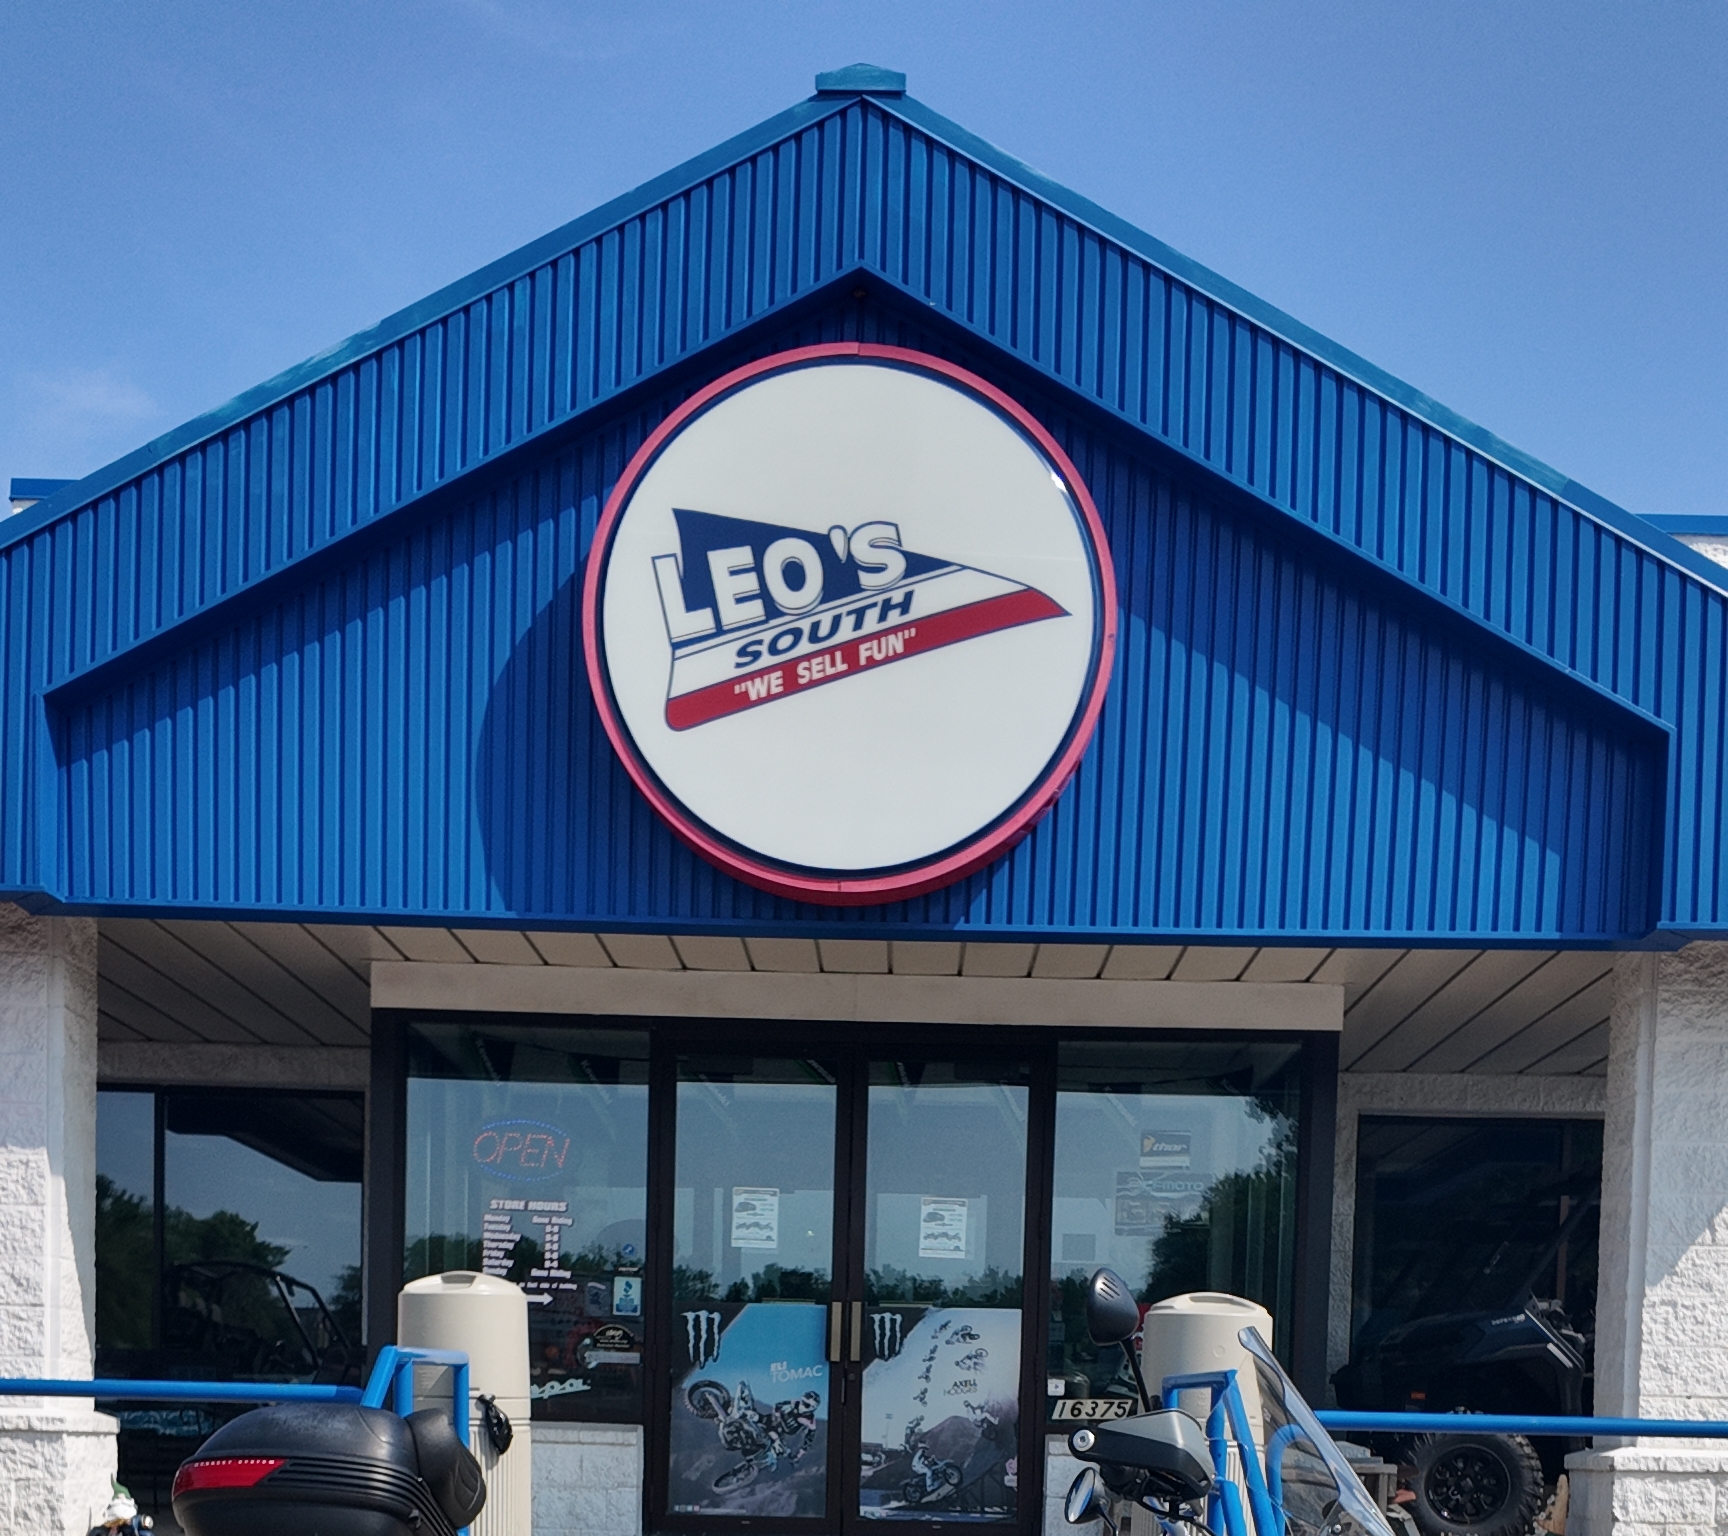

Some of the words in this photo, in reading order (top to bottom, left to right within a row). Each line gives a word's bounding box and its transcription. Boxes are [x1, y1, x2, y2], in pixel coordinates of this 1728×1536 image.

[651, 520, 907, 649] LEO'S
[733, 589, 915, 669] SOUTH
[734, 671, 784, 701] "WE
[796, 651, 849, 684] SELL
[858, 627, 917, 666] FUN"
[472, 1131, 571, 1168] OPEN
[489, 1199, 526, 1211] STORE
[527, 1201, 568, 1212] HOURS
[770, 1364, 823, 1383] TOMAC
[1058, 1401, 1129, 1418] 16375
